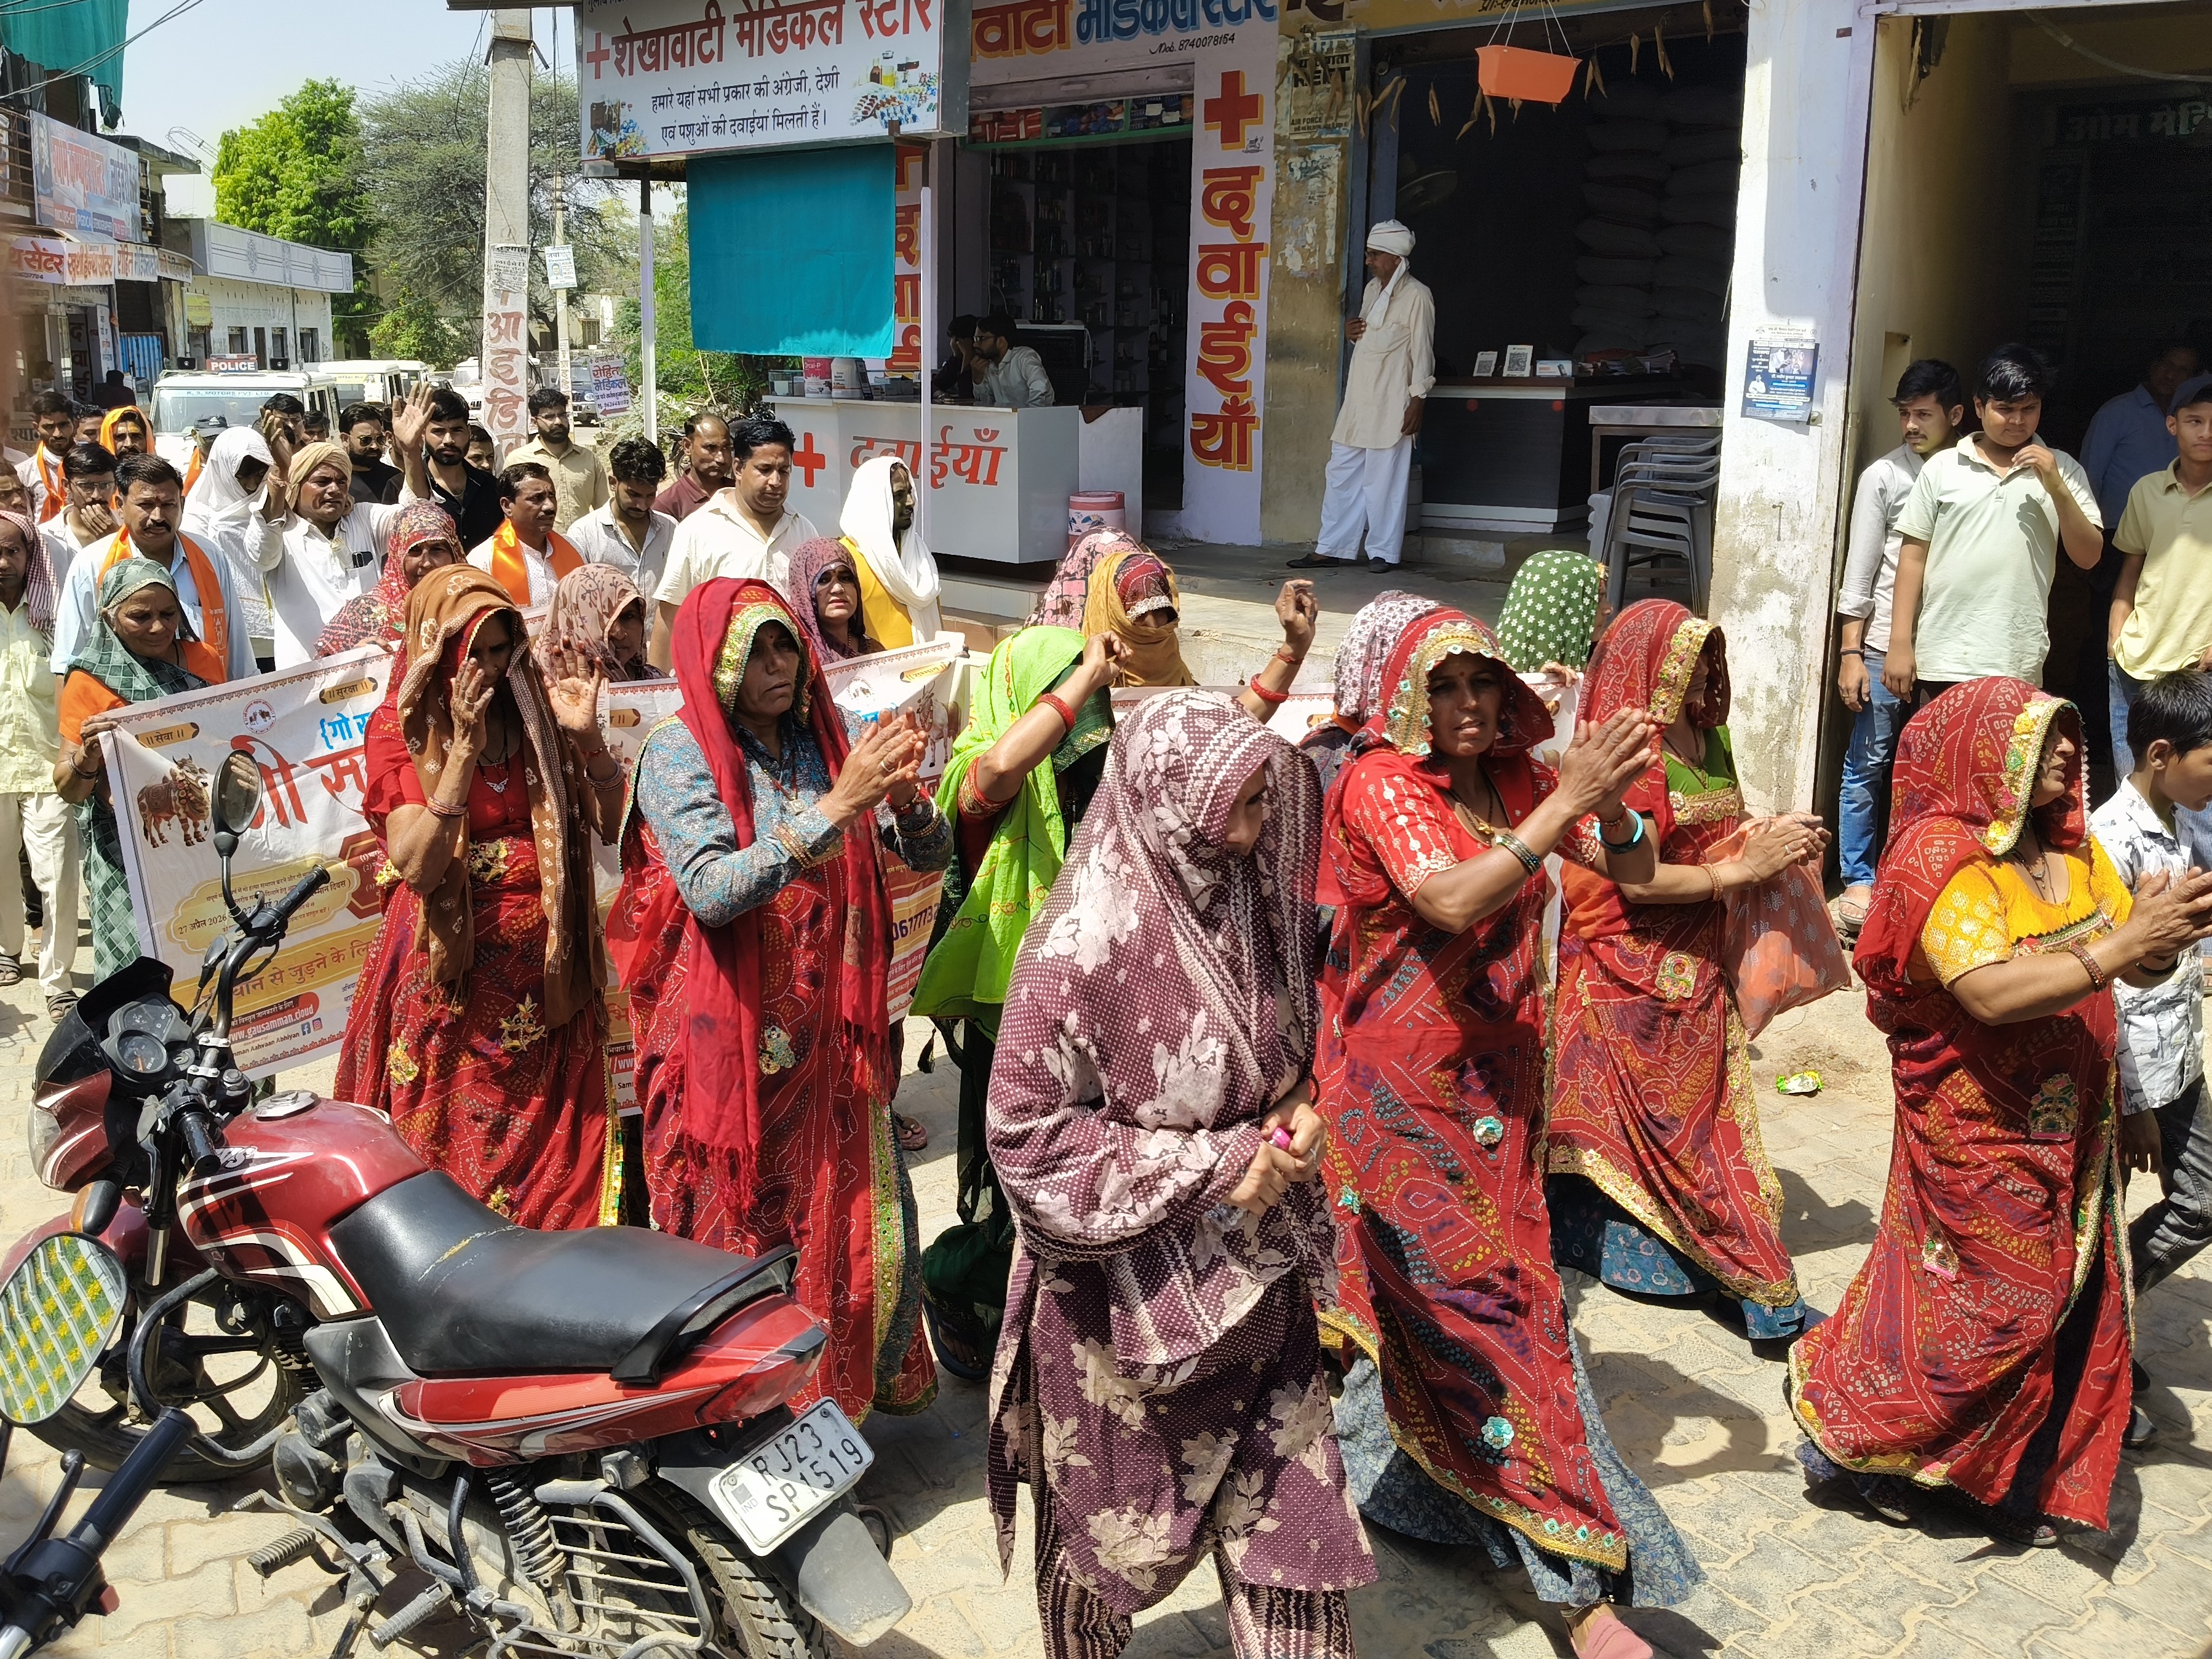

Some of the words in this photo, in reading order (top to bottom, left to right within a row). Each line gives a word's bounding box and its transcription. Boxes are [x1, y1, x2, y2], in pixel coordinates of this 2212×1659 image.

[611, 0, 726, 78] शेखावाटी
[651, 87, 674, 114] हमारे
[676, 85, 696, 109] यहां
[697, 81, 721, 107] सभी
[723, 83, 750, 103] प्रकार
[754, 75, 770, 97] की
[773, 70, 811, 97] अंग्रेजी,
[814, 65, 840, 93] देशी
[661, 119, 677, 146] एवं
[678, 115, 710, 146] पशुओं
[712, 114, 726, 136] की
[729, 109, 770, 138] दवाईयां
[772, 105, 808, 131] मिलती
[1303, 116, 1322, 125] FORCE
[24, 240, 64, 275] सेंटर
[211, 362, 255, 370] POLICE
[592, 364, 620, 379] रोहित
[594, 379, 627, 391] मेडिकल
[189, 918, 207, 931] अप्रैल
[207, 913, 228, 926] 2026
[330, 880, 346, 891] दिवस
[270, 966, 285, 986] से
[288, 952, 327, 984] जुड़ने
[330, 947, 346, 964] के
[349, 939, 372, 959] लि
[228, 1004, 314, 1042] ww.gausamman.cloud
[250, 1040, 275, 1052] Aahvaan
[276, 1032, 300, 1043] Abhiyan
[607, 1045, 626, 1054] भियान
[751, 1423, 822, 1487] RJ23
[741, 1498, 758, 1514] IND
